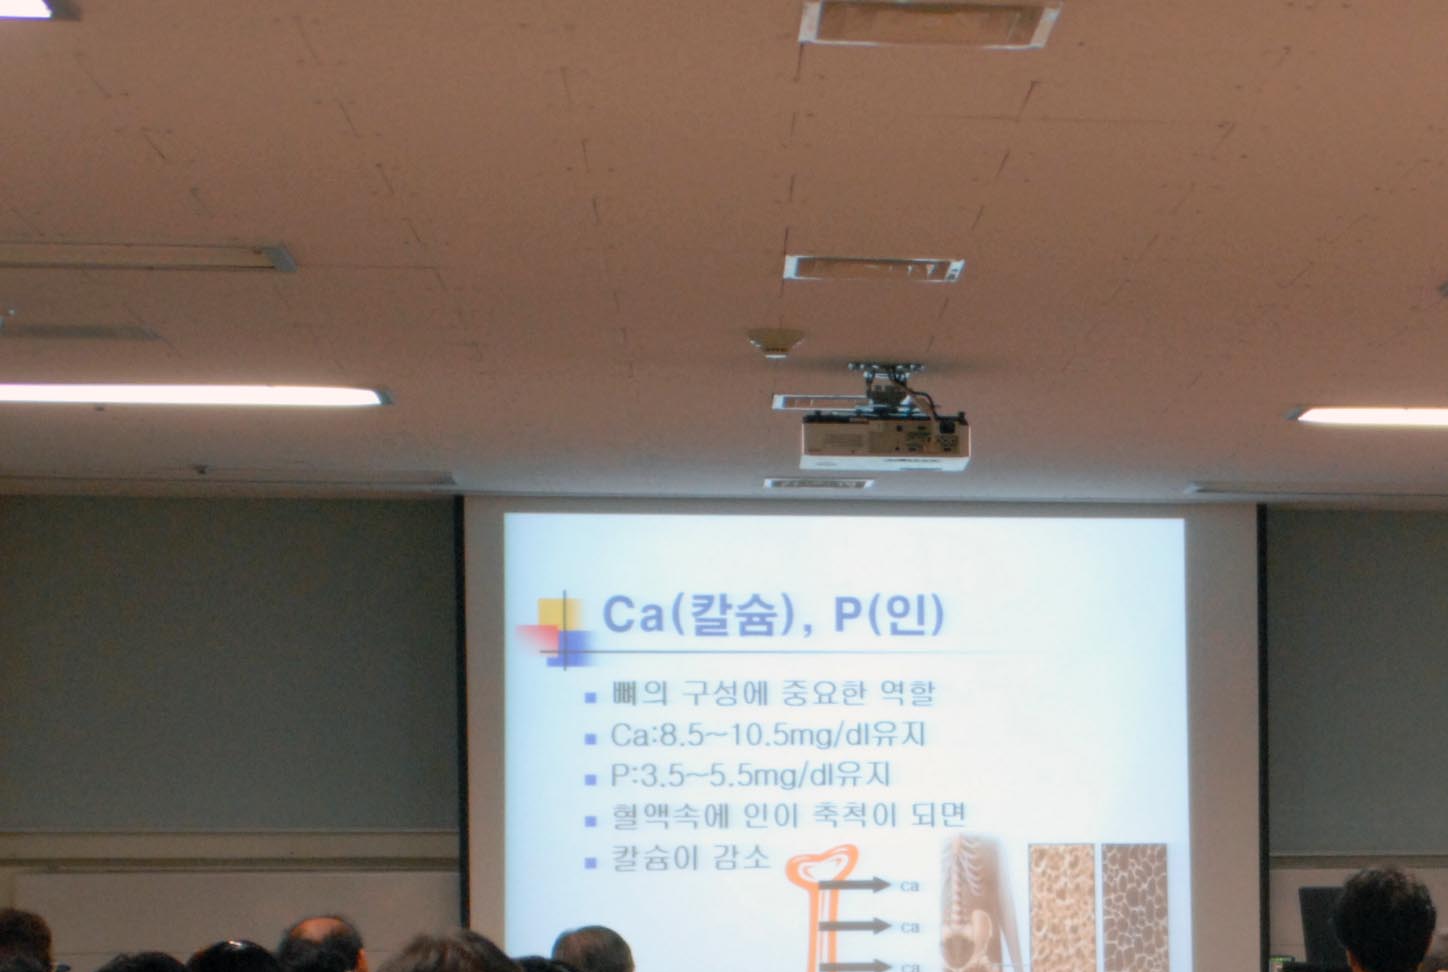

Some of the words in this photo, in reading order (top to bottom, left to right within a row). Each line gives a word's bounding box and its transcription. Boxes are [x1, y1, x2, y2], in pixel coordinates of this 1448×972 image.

[602, 591, 813, 638] Ca(칼슘),
[834, 592, 945, 637] P(인)
[612, 679, 668, 707] 뼈의
[683, 679, 769, 706] 구성에
[782, 679, 868, 706] 중요한
[881, 679, 937, 706] 역할
[612, 802, 730, 830] 혈액속에
[743, 802, 799, 828] 인이
[911, 802, 966, 828] 되면
[612, 844, 699, 872] 칼슘이
[713, 844, 771, 871] 감소
